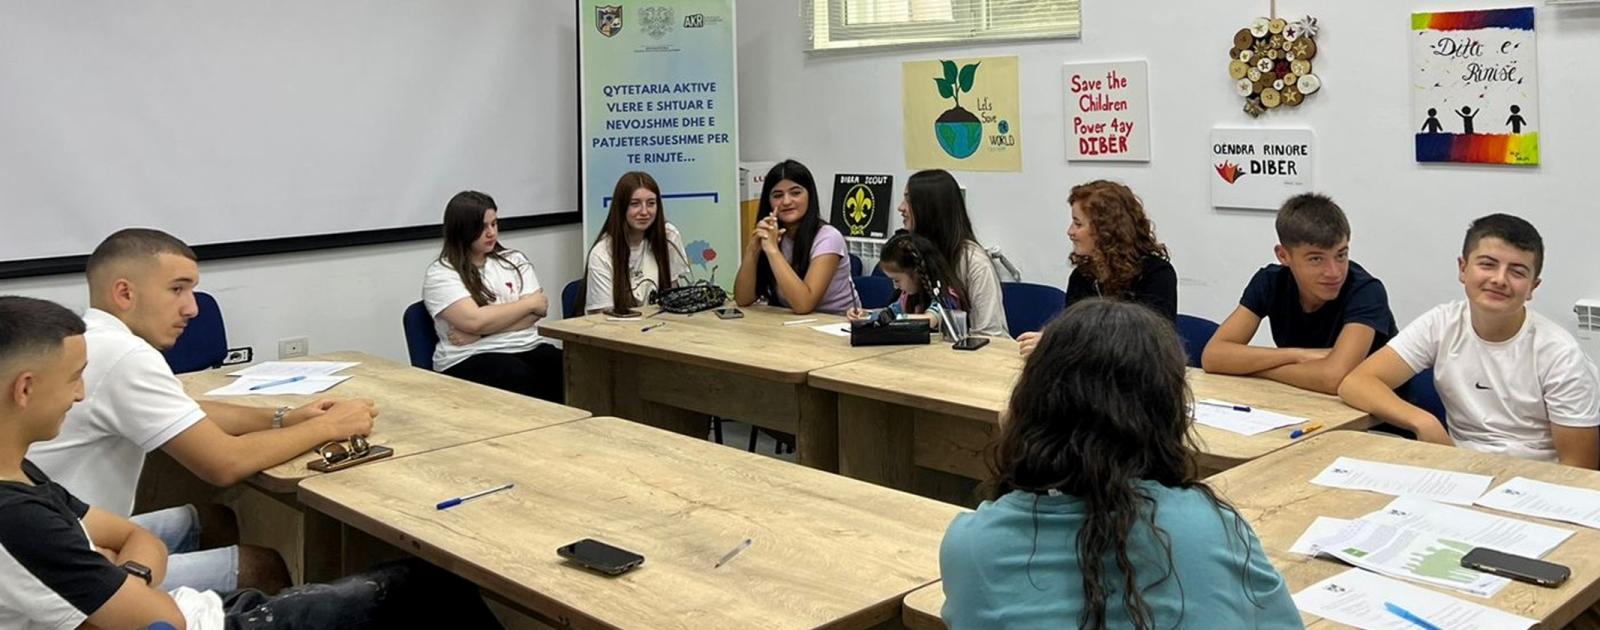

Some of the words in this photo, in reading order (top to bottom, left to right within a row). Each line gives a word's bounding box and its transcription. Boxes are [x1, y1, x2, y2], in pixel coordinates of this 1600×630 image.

[685, 14, 703, 28] AKR
[1071, 74, 1102, 93] Save
[1106, 70, 1127, 90] the
[603, 84, 670, 97] QYTETARIA
[673, 82, 716, 93] AKTIVE
[607, 102, 644, 112] VLERE
[646, 102, 653, 112] E
[657, 100, 704, 111] SHTUAR
[706, 100, 714, 109] E
[1079, 94, 1128, 112] Children
[606, 118, 679, 130] NEVOJSHME
[682, 117, 706, 127] DHE
[708, 117, 715, 127] E
[1074, 117, 1106, 134] Power
[1110, 118, 1134, 137] 4ay
[592, 134, 704, 148] PATJETERSUESHME
[708, 133, 729, 144] PER
[989, 134, 1015, 146] WORLD
[1079, 134, 1128, 155] DIBËR
[1263, 144, 1308, 156] RINORE
[627, 154, 642, 164] TE
[644, 152, 695, 164] RINJTE...
[864, 176, 888, 184] SCOUT
